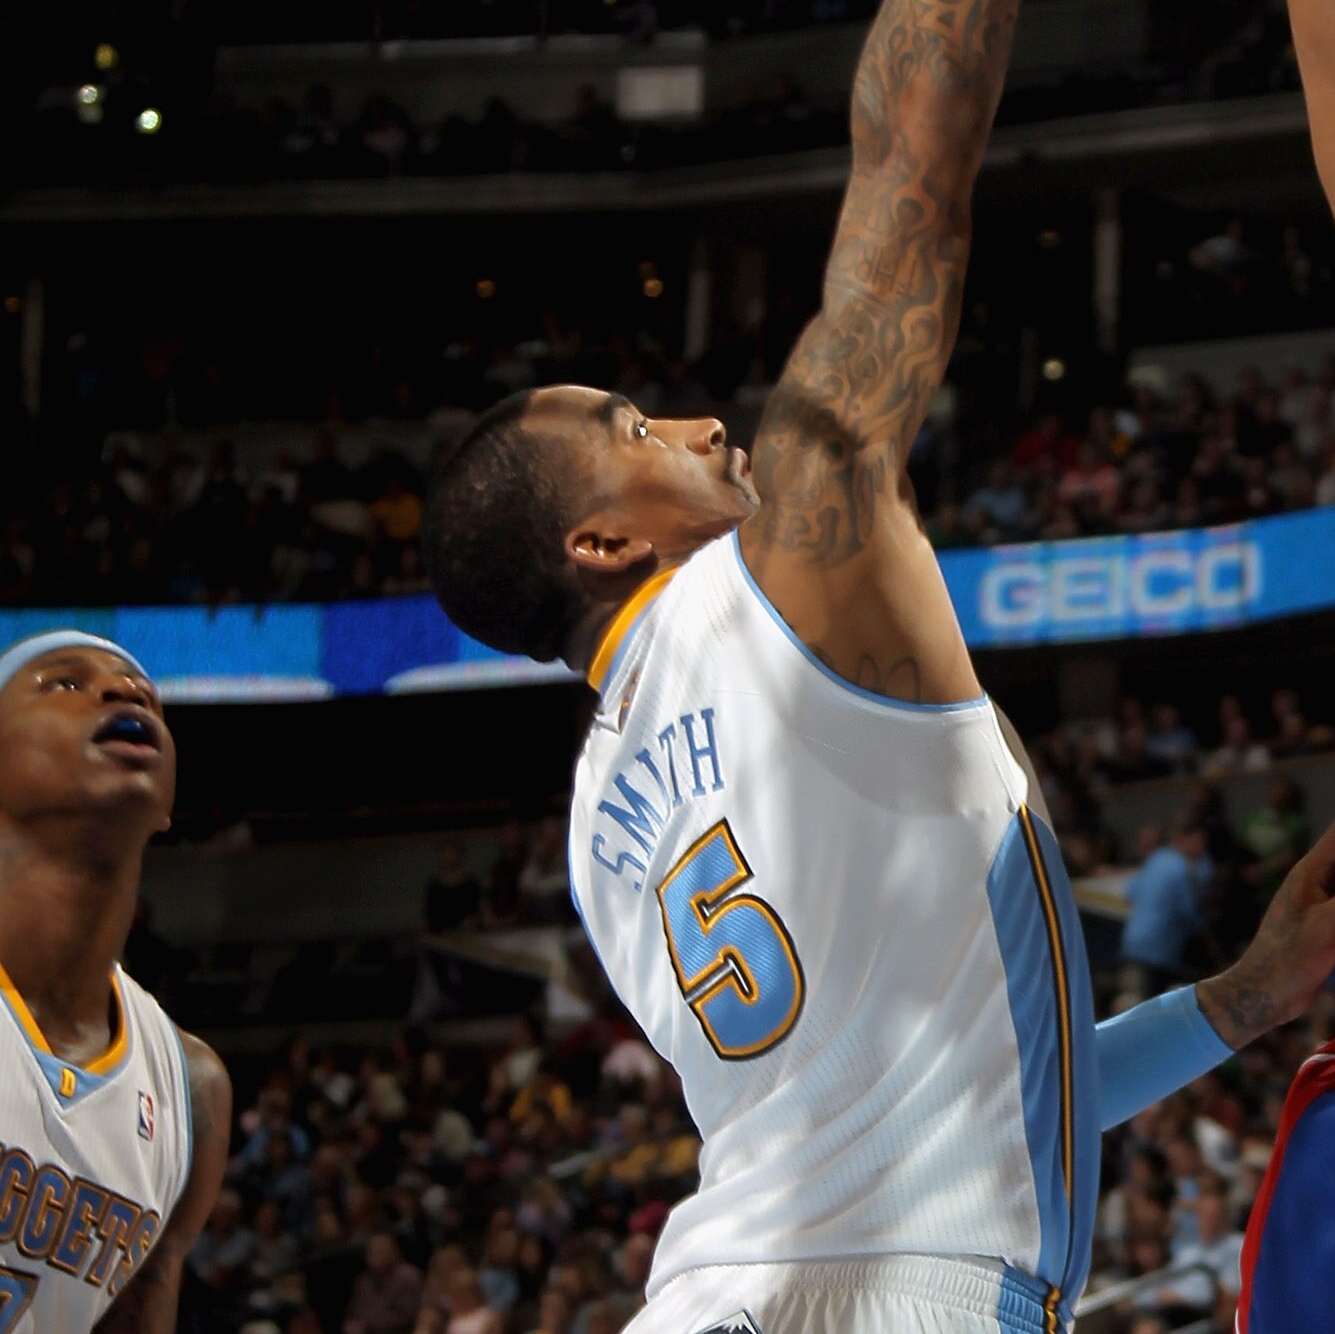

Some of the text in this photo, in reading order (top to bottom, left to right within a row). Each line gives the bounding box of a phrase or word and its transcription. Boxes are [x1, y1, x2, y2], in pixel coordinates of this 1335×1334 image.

[977, 540, 1264, 631] GEICO
[591, 707, 727, 893] SMITH
[656, 817, 806, 1062] 5
